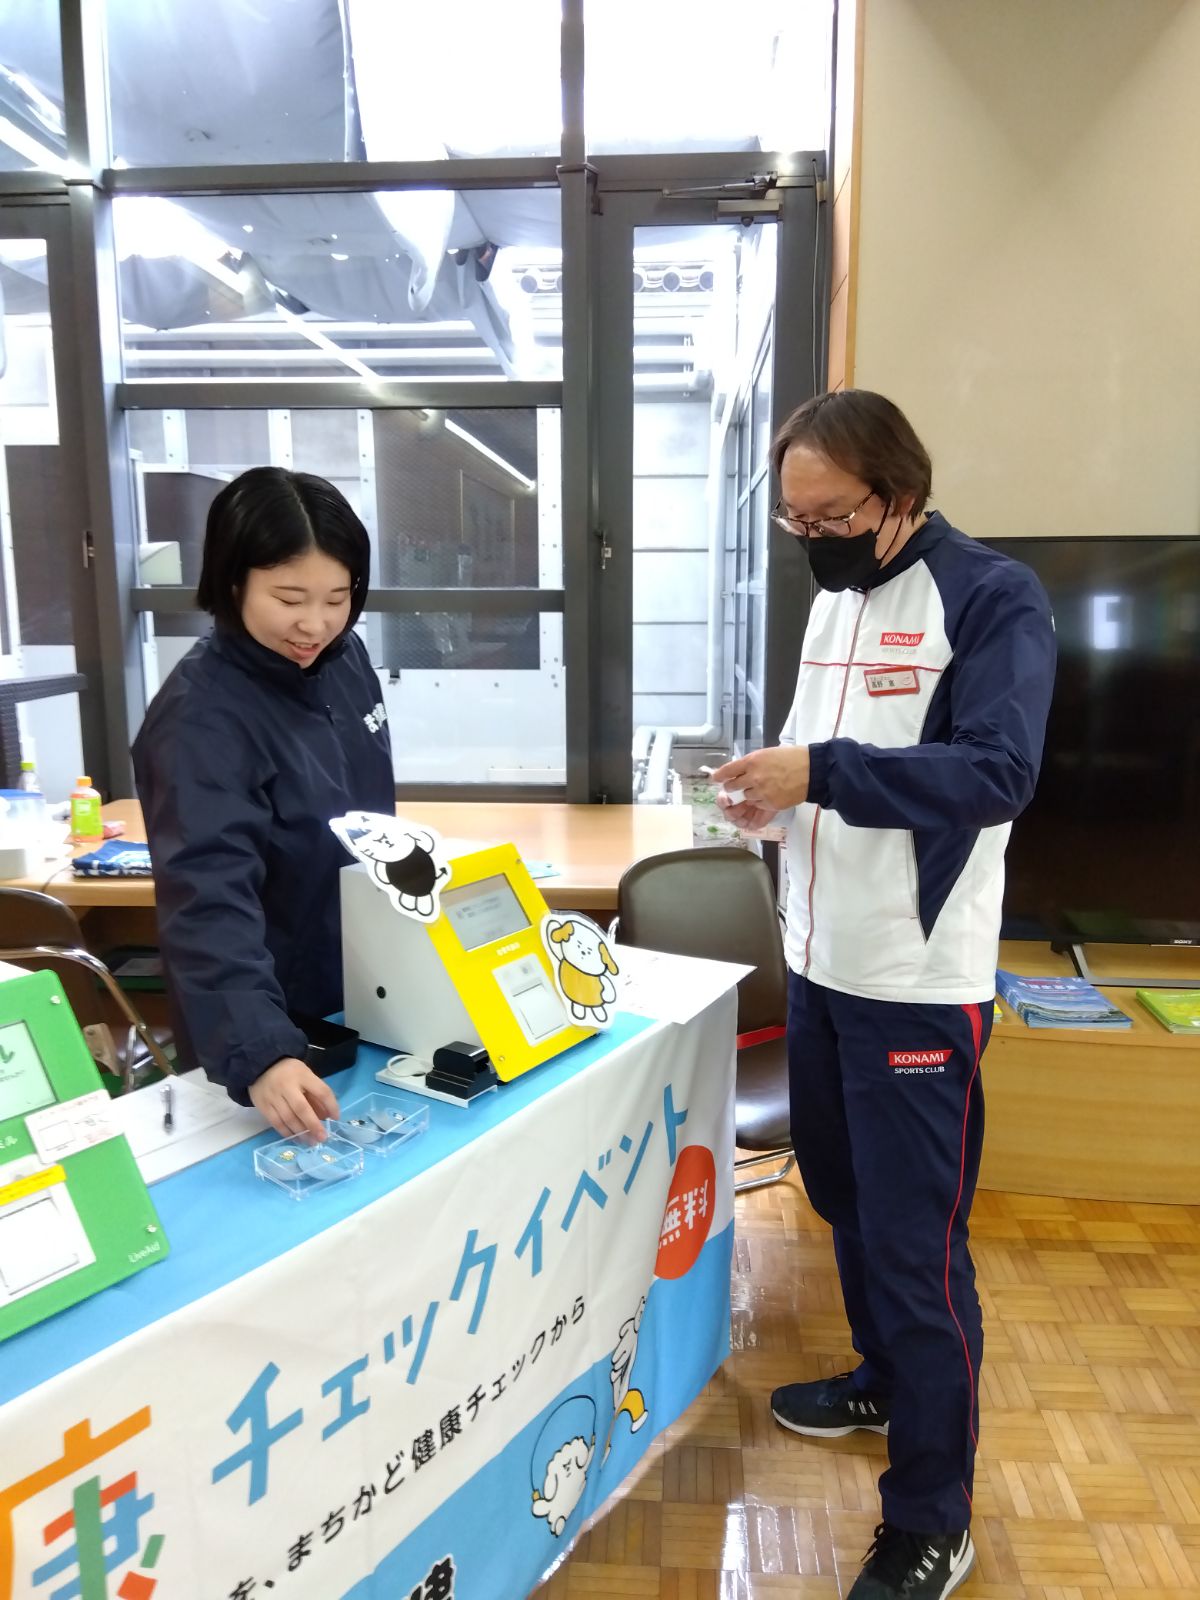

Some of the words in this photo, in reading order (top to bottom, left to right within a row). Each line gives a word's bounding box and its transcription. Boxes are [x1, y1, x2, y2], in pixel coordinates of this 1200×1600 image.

[883, 634, 921, 645] KONAMI
[893, 1052, 945, 1064] KONAMI
[894, 1067, 924, 1075] SPORTS
[925, 1066, 945, 1074] CLUB
[659, 1179, 709, 1250] 無料
